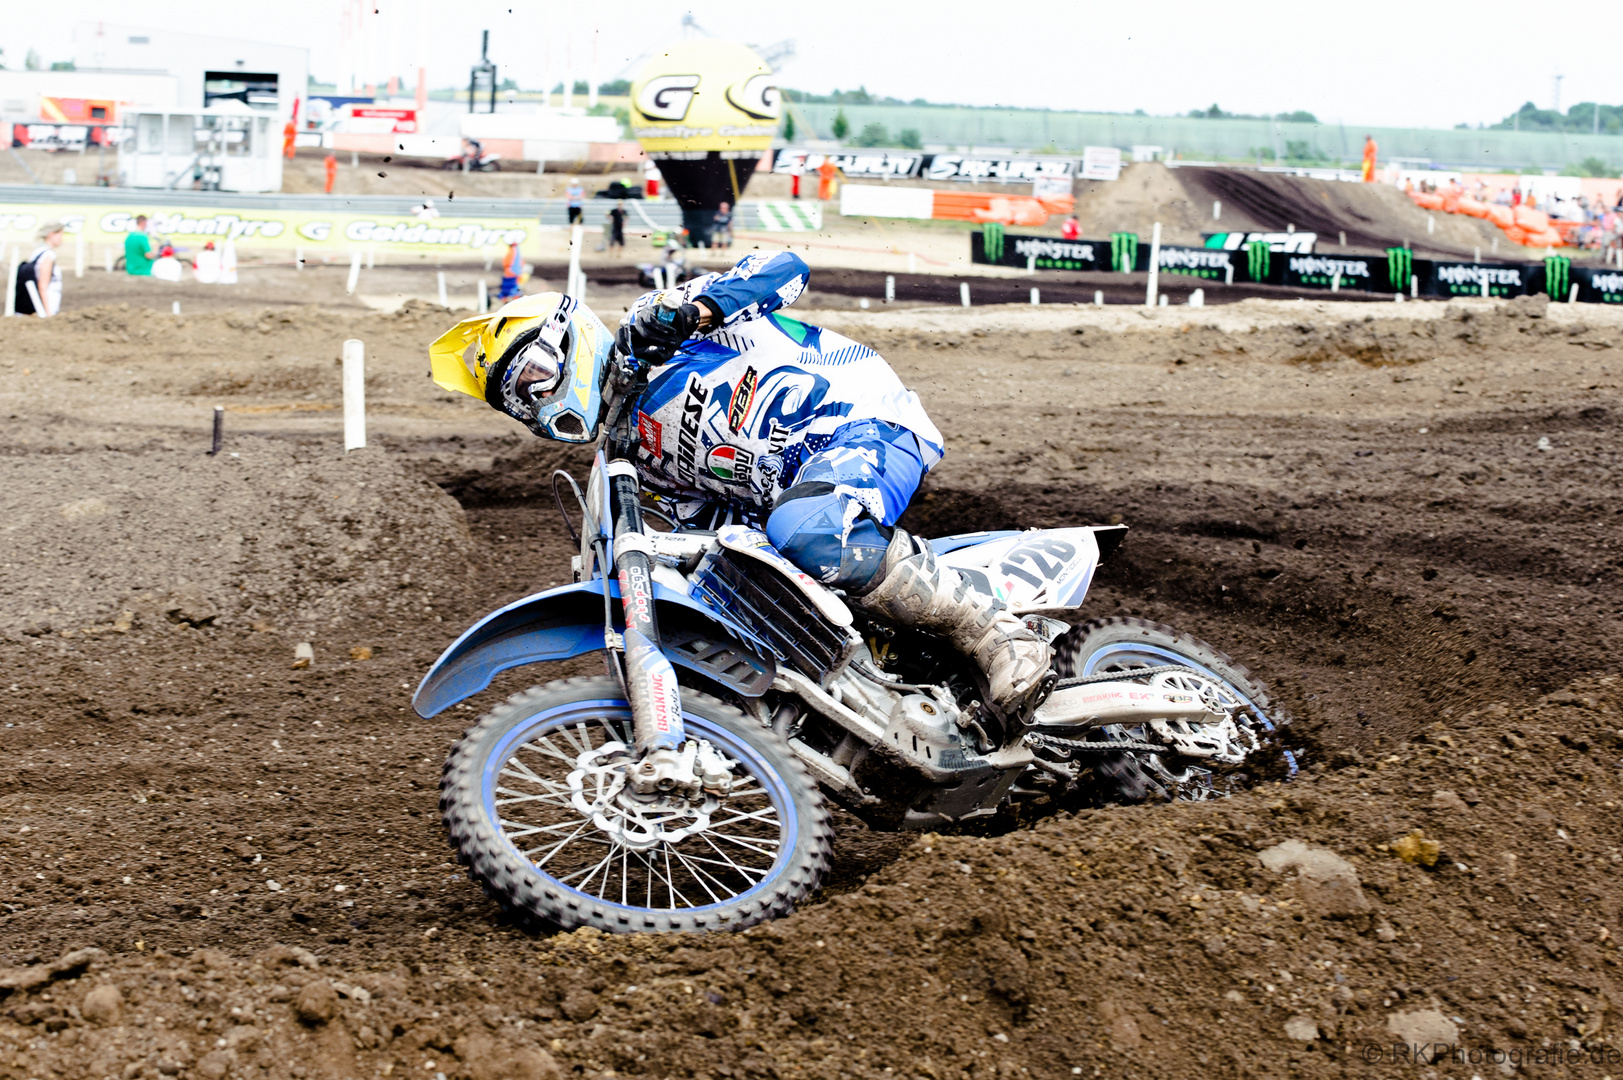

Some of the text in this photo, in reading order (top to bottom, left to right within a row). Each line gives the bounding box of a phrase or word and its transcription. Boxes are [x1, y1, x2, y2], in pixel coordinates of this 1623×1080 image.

[634, 74, 701, 121] G
[345, 221, 527, 248] GoldenTyre
[1016, 240, 1094, 261] MONSTER
[1290, 257, 1369, 277] MONSTER
[1439, 266, 1521, 285] MONSTER
[729, 365, 758, 437] PBR
[999, 539, 1077, 590] 128
[651, 673, 669, 732] BRAKING
[1082, 691, 1123, 704] BRAKING
